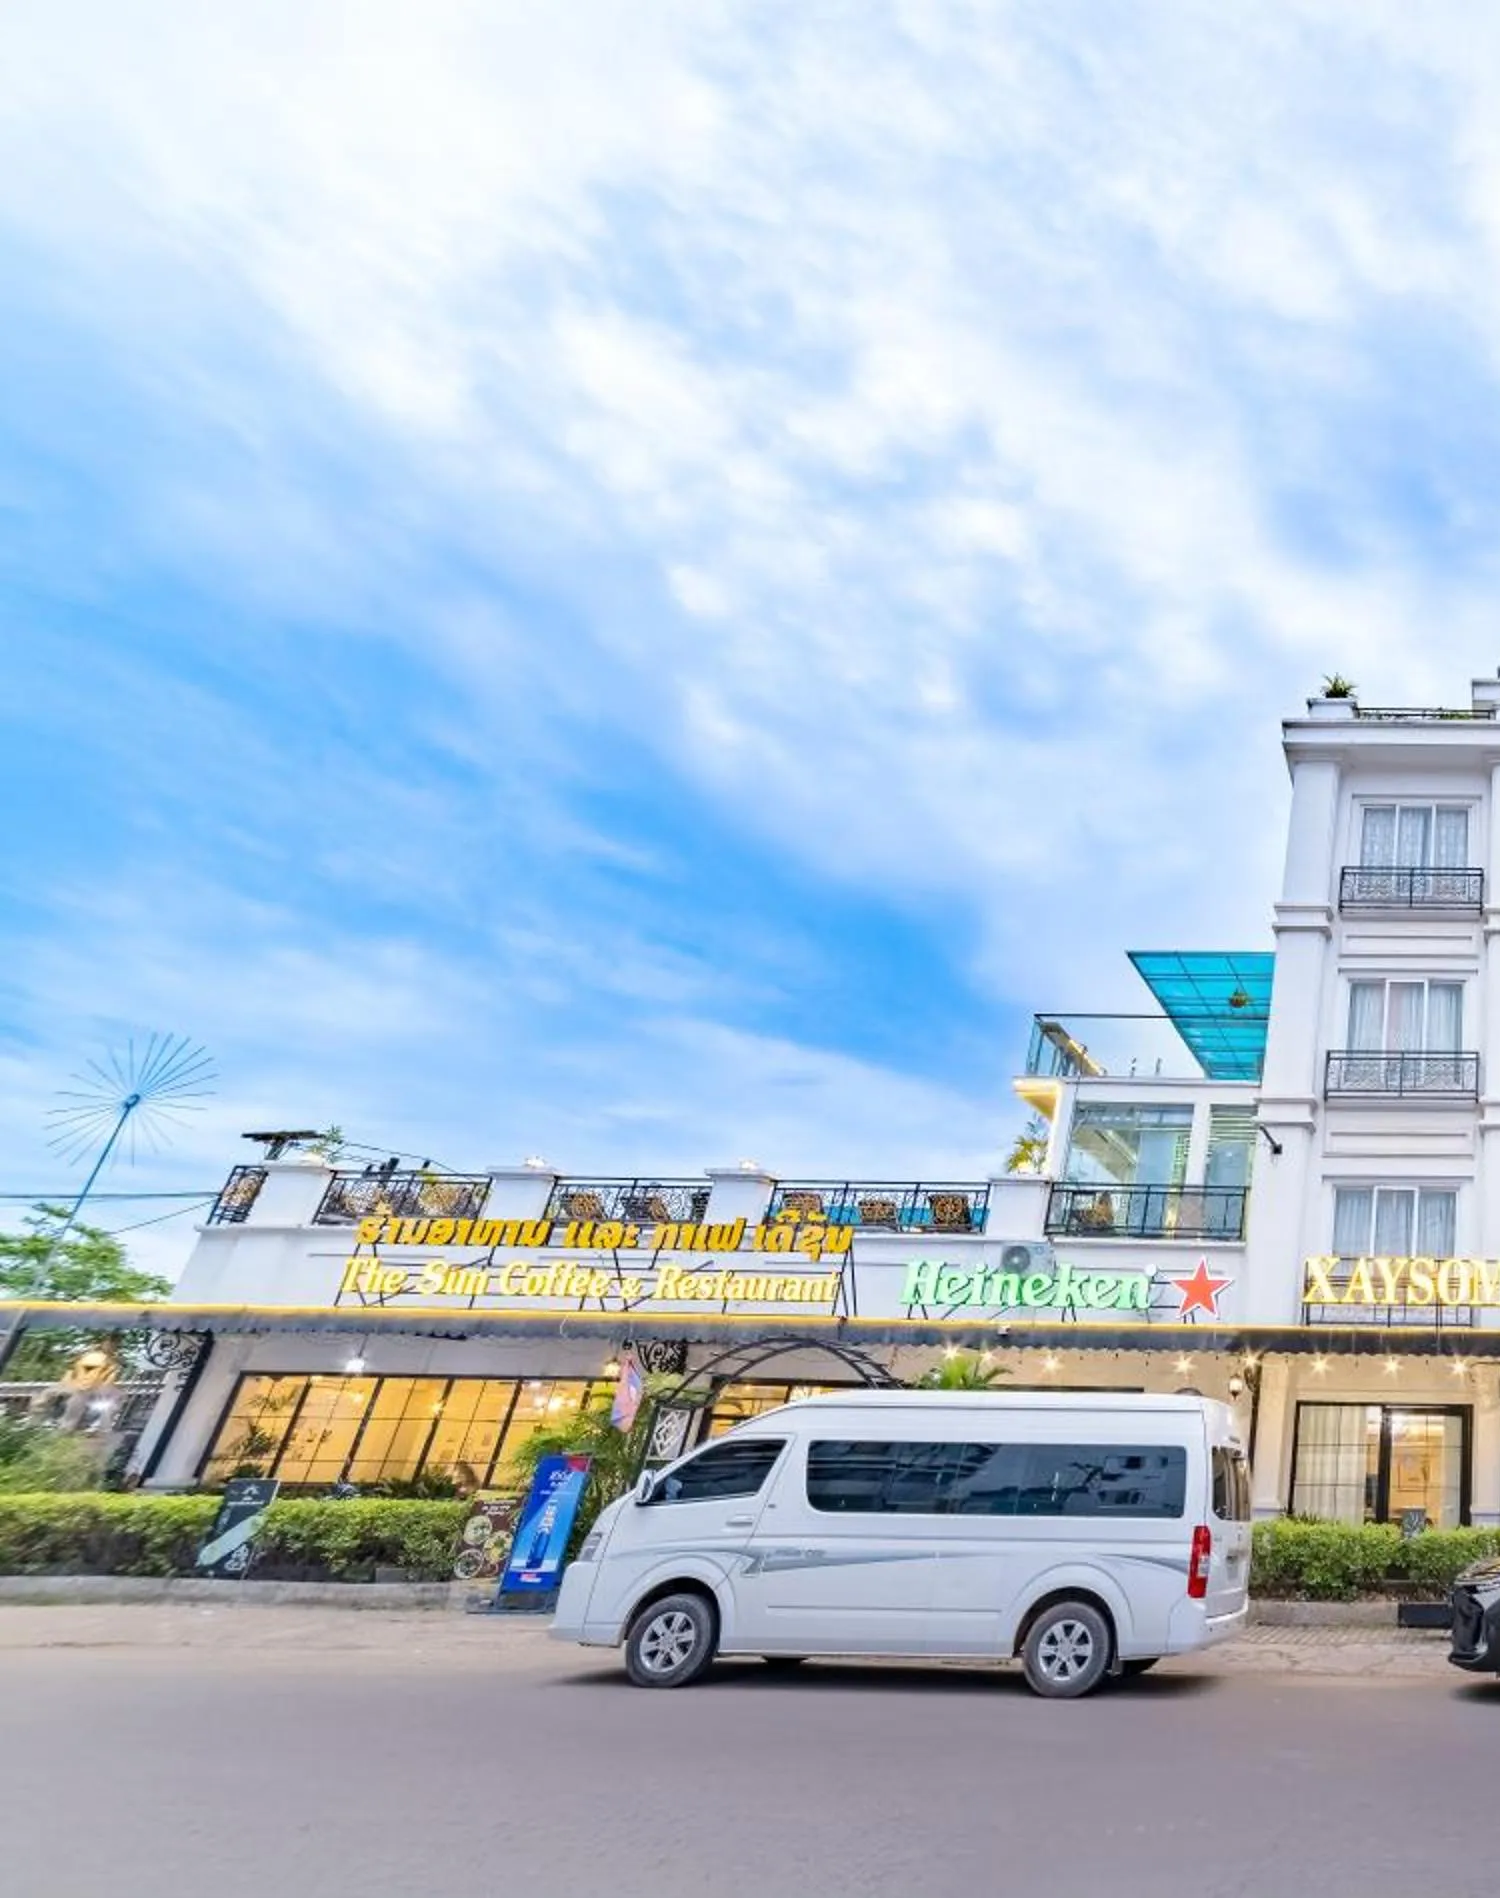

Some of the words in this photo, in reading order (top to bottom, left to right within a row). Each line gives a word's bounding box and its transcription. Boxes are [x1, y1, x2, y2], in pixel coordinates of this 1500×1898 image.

[343, 1255, 408, 1294] The
[414, 1259, 490, 1296] Sun
[500, 1260, 612, 1299] Coffee
[617, 1275, 644, 1300] &
[654, 1263, 843, 1302] Restaurant
[899, 1258, 1154, 1311] Heineken
